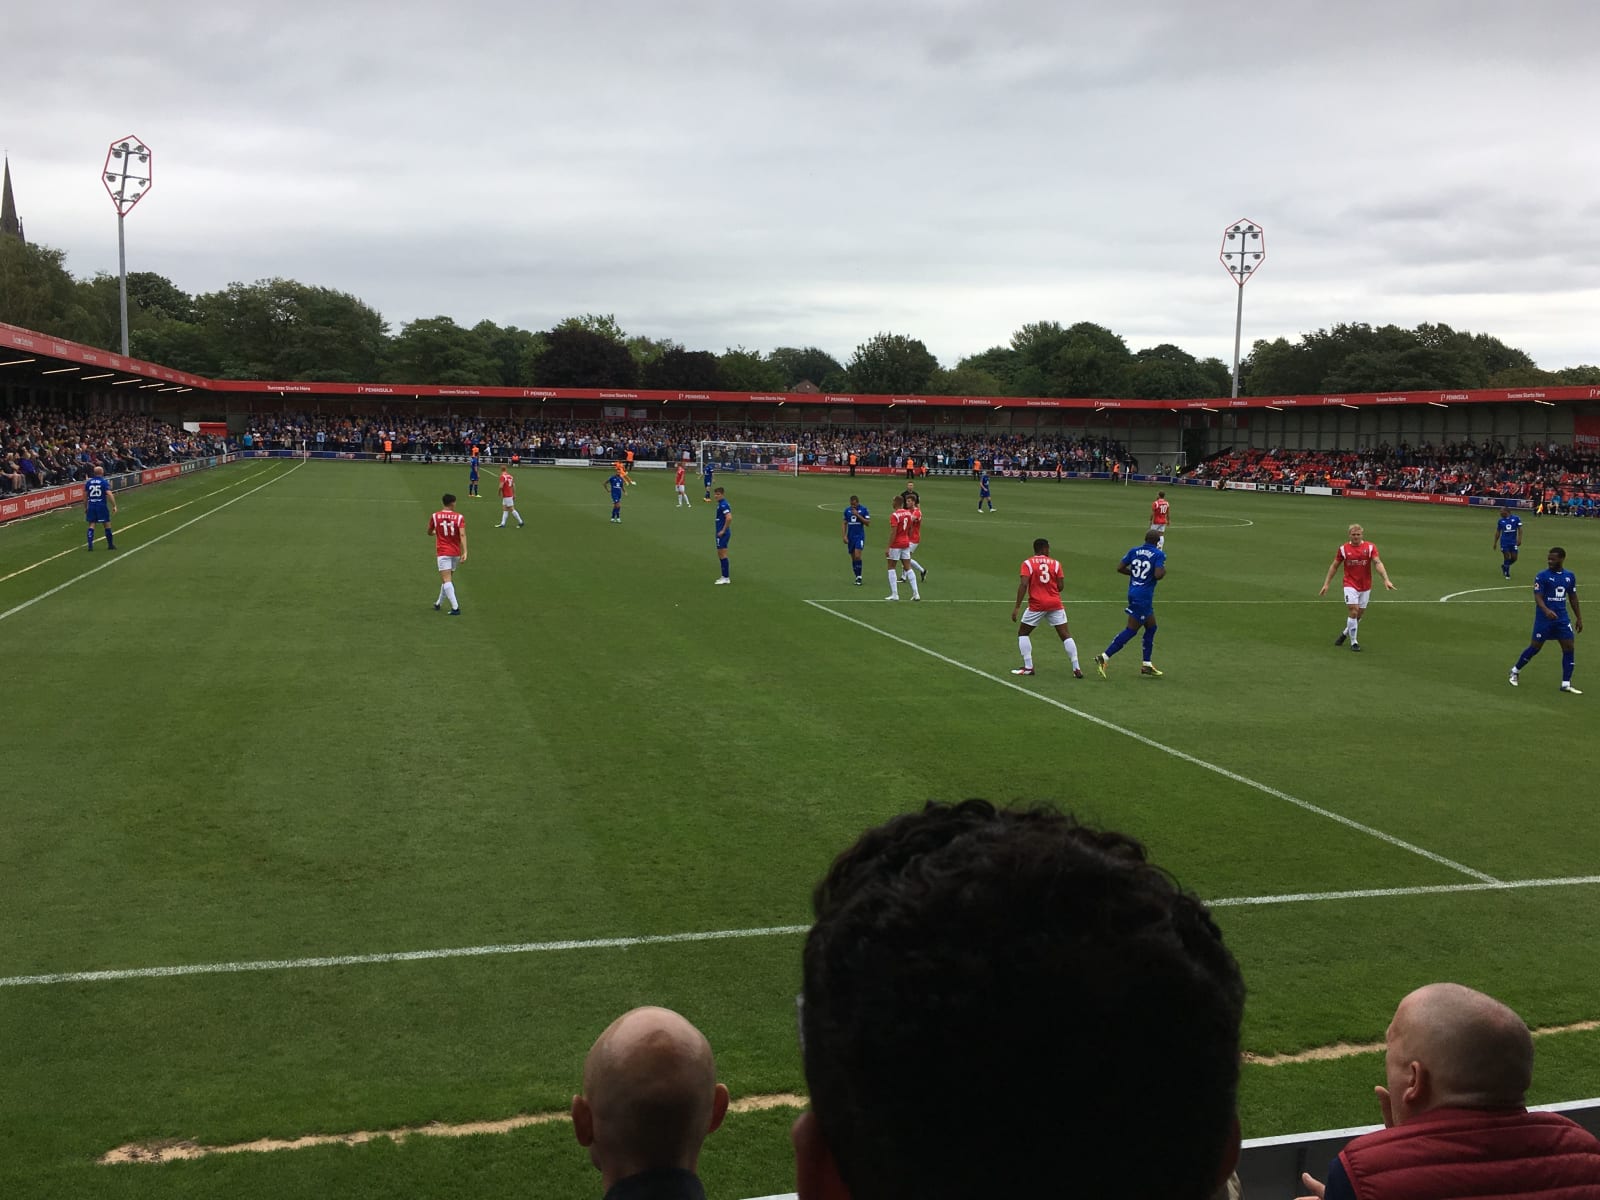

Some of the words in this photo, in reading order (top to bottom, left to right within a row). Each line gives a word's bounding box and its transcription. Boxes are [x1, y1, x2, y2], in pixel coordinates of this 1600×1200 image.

[89, 485, 102, 496] 25
[1160, 504, 1166, 514] 10
[440, 520, 454, 536] 11
[1039, 564, 1049, 583] 3
[1132, 559, 1151, 579] 32
